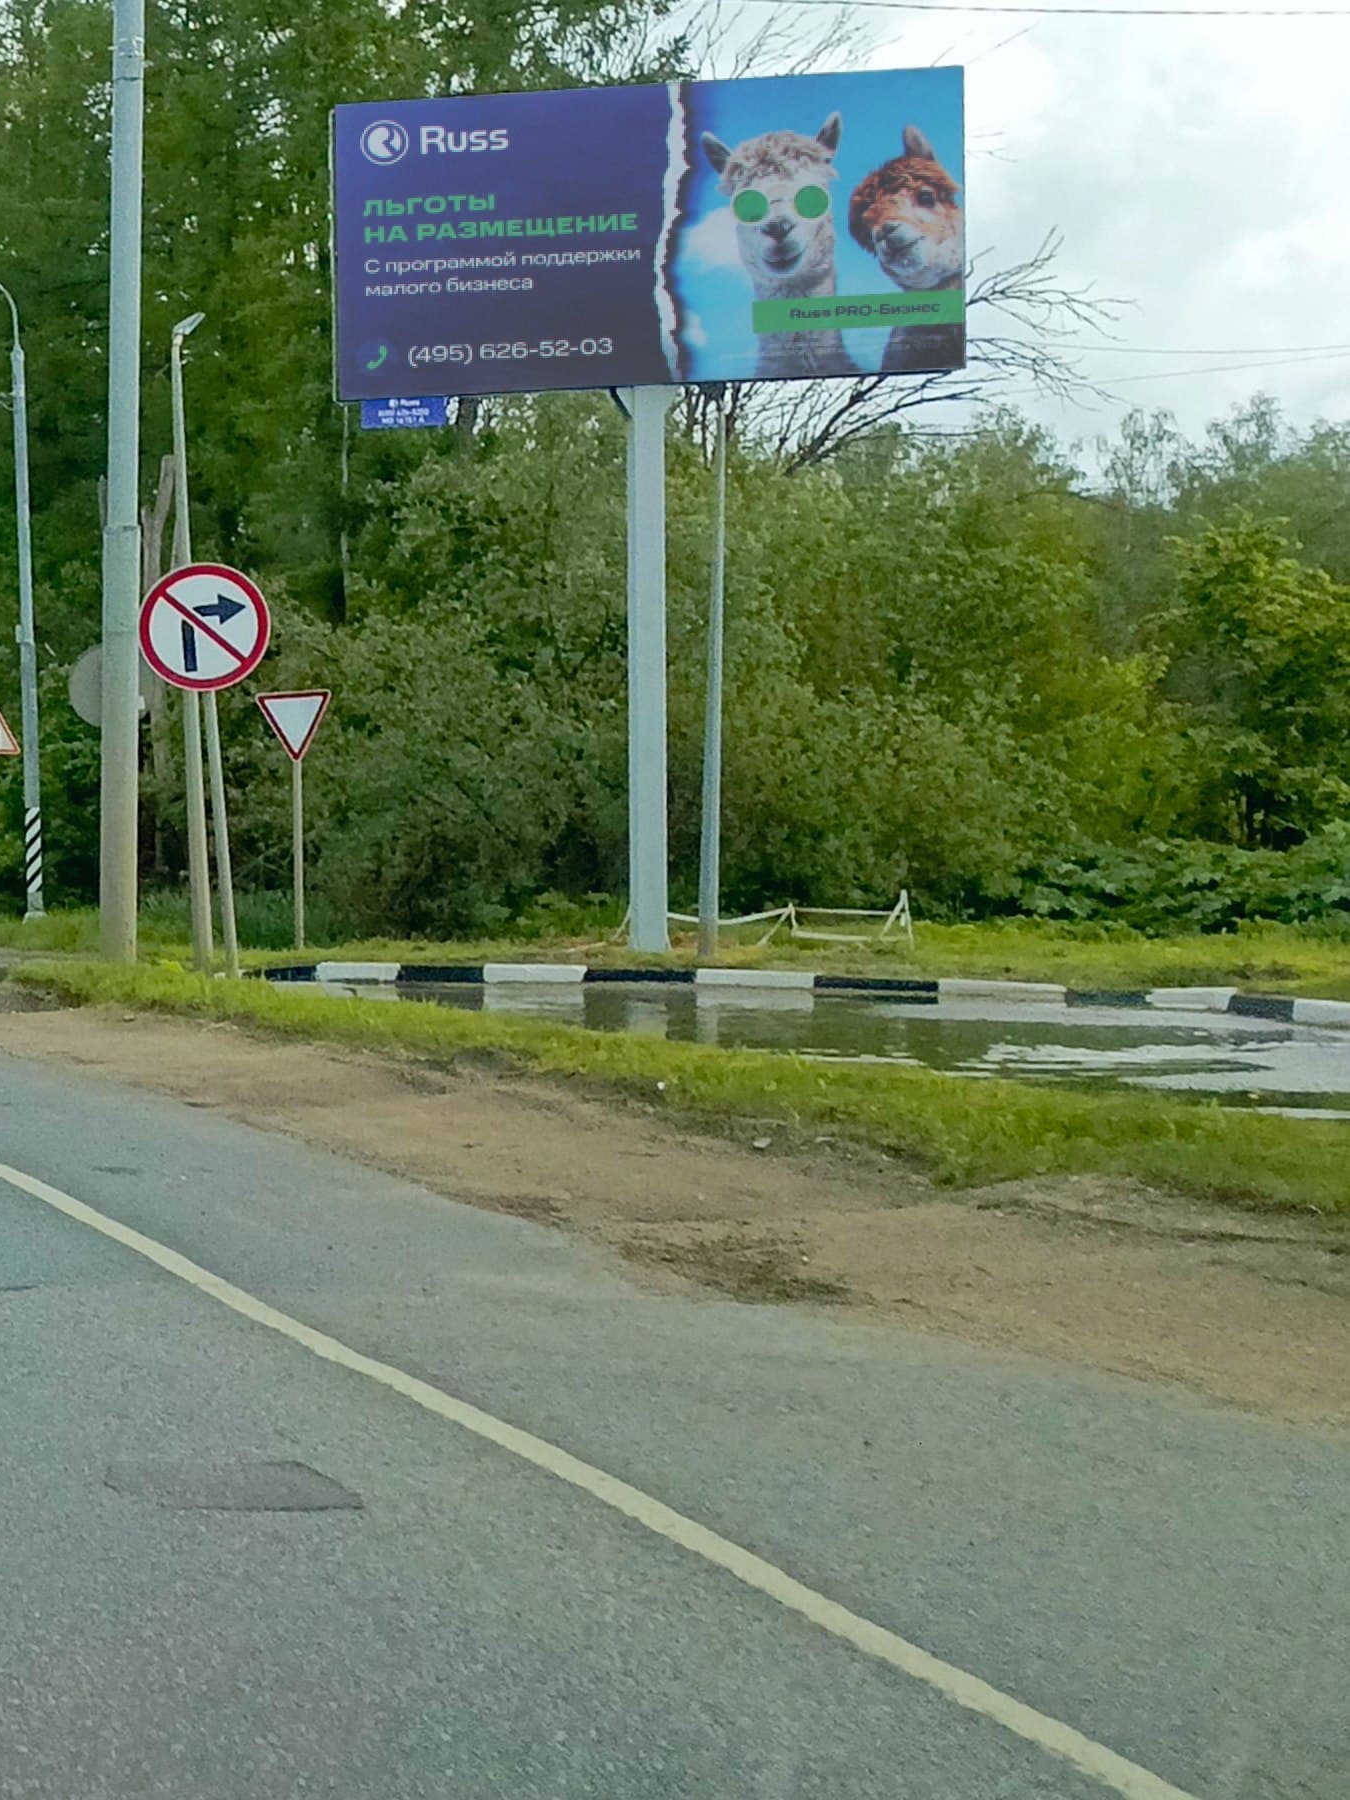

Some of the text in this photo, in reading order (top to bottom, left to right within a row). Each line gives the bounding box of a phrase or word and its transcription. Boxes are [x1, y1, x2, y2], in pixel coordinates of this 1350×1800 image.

[419, 125, 510, 155] Russ
[363, 194, 495, 217] ЛЬГОТЫ
[363, 213, 639, 244] НА РАЗМЕЩЕНИЕ
[364, 248, 641, 277] С программой поддержки
[365, 276, 535, 297] малого бизнеса
[789, 308, 832, 320] Russ
[407, 336, 613, 368] (495) 626-52-03
